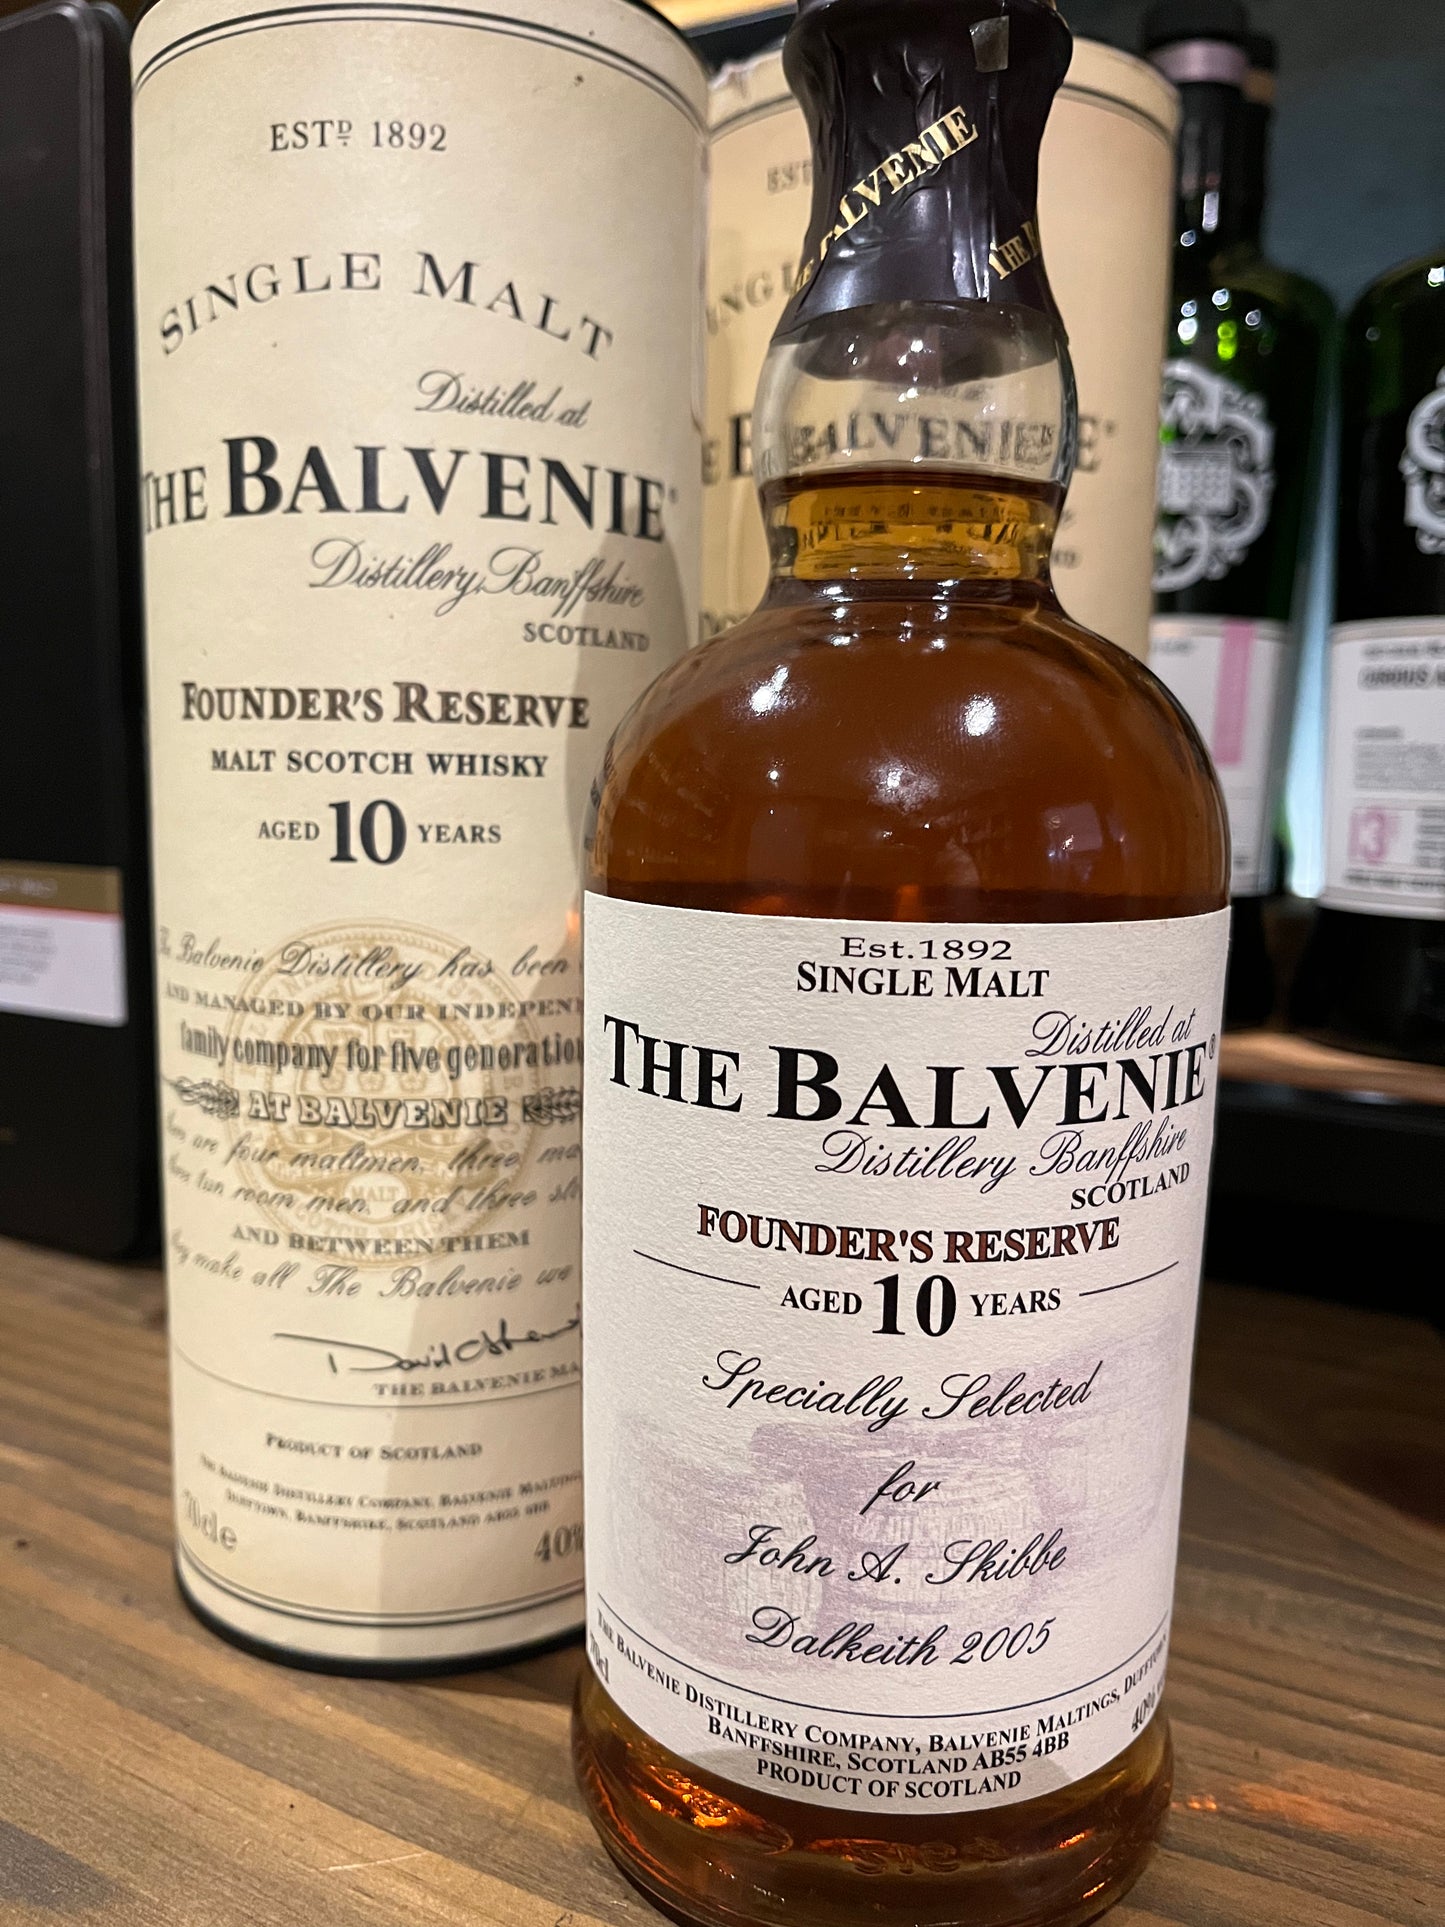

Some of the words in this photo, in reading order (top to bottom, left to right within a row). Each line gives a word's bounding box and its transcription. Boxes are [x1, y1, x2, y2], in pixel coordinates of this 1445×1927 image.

[371, 121, 448, 152] 1892
[160, 251, 382, 356] SINGLE
[412, 250, 615, 362] MALT
[414, 368, 562, 426] Distilled
[556, 398, 592, 429] at
[140, 466, 209, 535] THE
[482, 545, 646, 618] Banffshire
[522, 622, 650, 653] SCOTLAND
[180, 680, 383, 723] FOUNDER'S
[391, 680, 590, 730] RESERVE
[210, 749, 277, 773] MALT
[286, 750, 413, 776] SCOTCH
[425, 752, 549, 779] WHISKY
[257, 820, 321, 842] AGED
[326, 798, 408, 866] 10
[416, 823, 502, 845] YEARS
[175, 930, 266, 975] Balvenie
[277, 940, 424, 992] Distillery
[436, 945, 497, 979] has
[510, 944, 571, 979] been
[796, 960, 935, 998] SINGLE
[944, 965, 1050, 999] MALT
[165, 980, 190, 1003] AND
[194, 986, 306, 1019] MANAGED
[314, 1001, 351, 1020] BY
[360, 1002, 425, 1022] OUR
[180, 1017, 230, 1068] family
[233, 1034, 339, 1079] company
[346, 1038, 387, 1072] for
[389, 1039, 441, 1074] five
[1024, 1004, 1166, 1060] Distilled
[1170, 1005, 1199, 1043] at
[602, 1013, 745, 1115] THE
[247, 1090, 292, 1122] AT
[298, 1094, 508, 1130] BALVENIE
[223, 1130, 280, 1168] four
[446, 1137, 521, 1171] three
[813, 1129, 1018, 1195] Distillery
[1028, 1121, 1188, 1182] Banffshire
[232, 1185, 295, 1209] room
[391, 1183, 465, 1214] and
[464, 1177, 538, 1212] three
[1070, 1160, 1191, 1212] SCOTLAND
[231, 1222, 281, 1246] AND
[287, 1230, 436, 1255] BETWEEN
[440, 1228, 532, 1254] THEM
[696, 1203, 935, 1265] FOUNDER'S
[942, 1216, 1121, 1264] RESERVE
[250, 1259, 302, 1289] all
[306, 1263, 364, 1299] The
[377, 1264, 523, 1299] Balvenie
[779, 1284, 863, 1317] AGED
[871, 1272, 959, 1338] 10
[970, 1287, 1063, 1319] YEARS
[372, 1381, 427, 1398] THE
[429, 1367, 547, 1396] BALVENIE
[701, 1348, 910, 1433] Specially
[921, 1358, 1105, 1421] Selected
[264, 1431, 345, 1460] PRODUCT
[349, 1444, 375, 1460] OF
[379, 1442, 484, 1463] SCOTLAND
[858, 1458, 941, 1516] for
[724, 1523, 836, 1581] John
[847, 1543, 902, 1585] A.
[924, 1526, 1067, 1587] Skibbe
[745, 1605, 952, 1667] Dalkeith
[948, 1616, 1058, 1667] 2005
[616, 1632, 681, 1696] BALVENIE
[684, 1682, 800, 1739] DISTILLERY
[804, 1724, 923, 1756] COMPANY,
[928, 1724, 1031, 1754] BALVENIE
[1036, 1687, 1122, 1736] MALTINGS,
[707, 1714, 842, 1771] BANFFSHIRE,
[846, 1751, 969, 1776] SCOTLAND
[971, 1745, 1029, 1773] AB55
[1031, 1730, 1071, 1759] 4BB
[755, 1757, 864, 1796] PRODUCT
[867, 1778, 901, 1798] OF
[903, 1769, 1023, 1800] SCOTLAND
